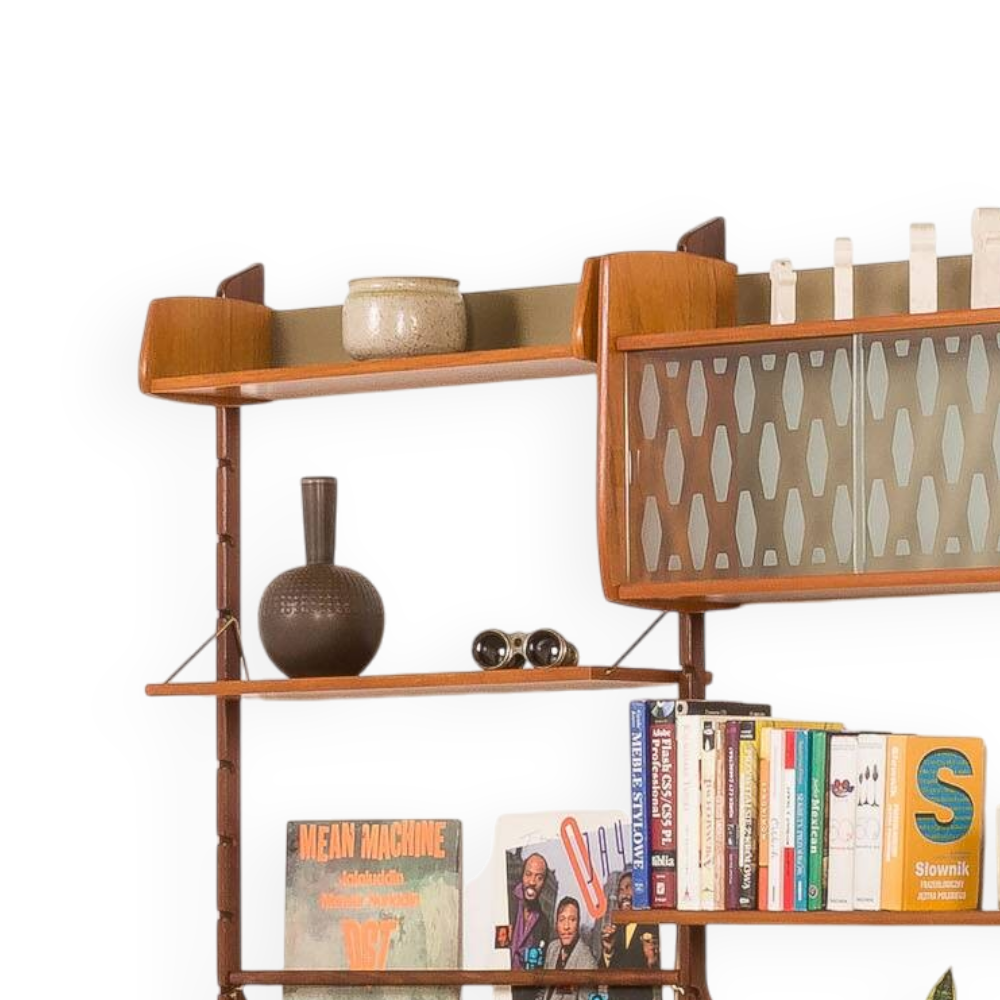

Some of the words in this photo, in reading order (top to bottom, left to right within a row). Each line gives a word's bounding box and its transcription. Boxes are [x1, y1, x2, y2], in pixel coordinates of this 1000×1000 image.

[631, 732, 643, 788] MEBLE
[652, 739, 661, 818] Professional
[661, 738, 672, 774] Flash
[914, 748, 975, 844] S
[300, 822, 355, 862] MEAN
[361, 820, 446, 860] MACHINE
[632, 791, 644, 870] STYLOWE
[810, 799, 820, 854] Mexican
[915, 860, 970, 877] Słownik
